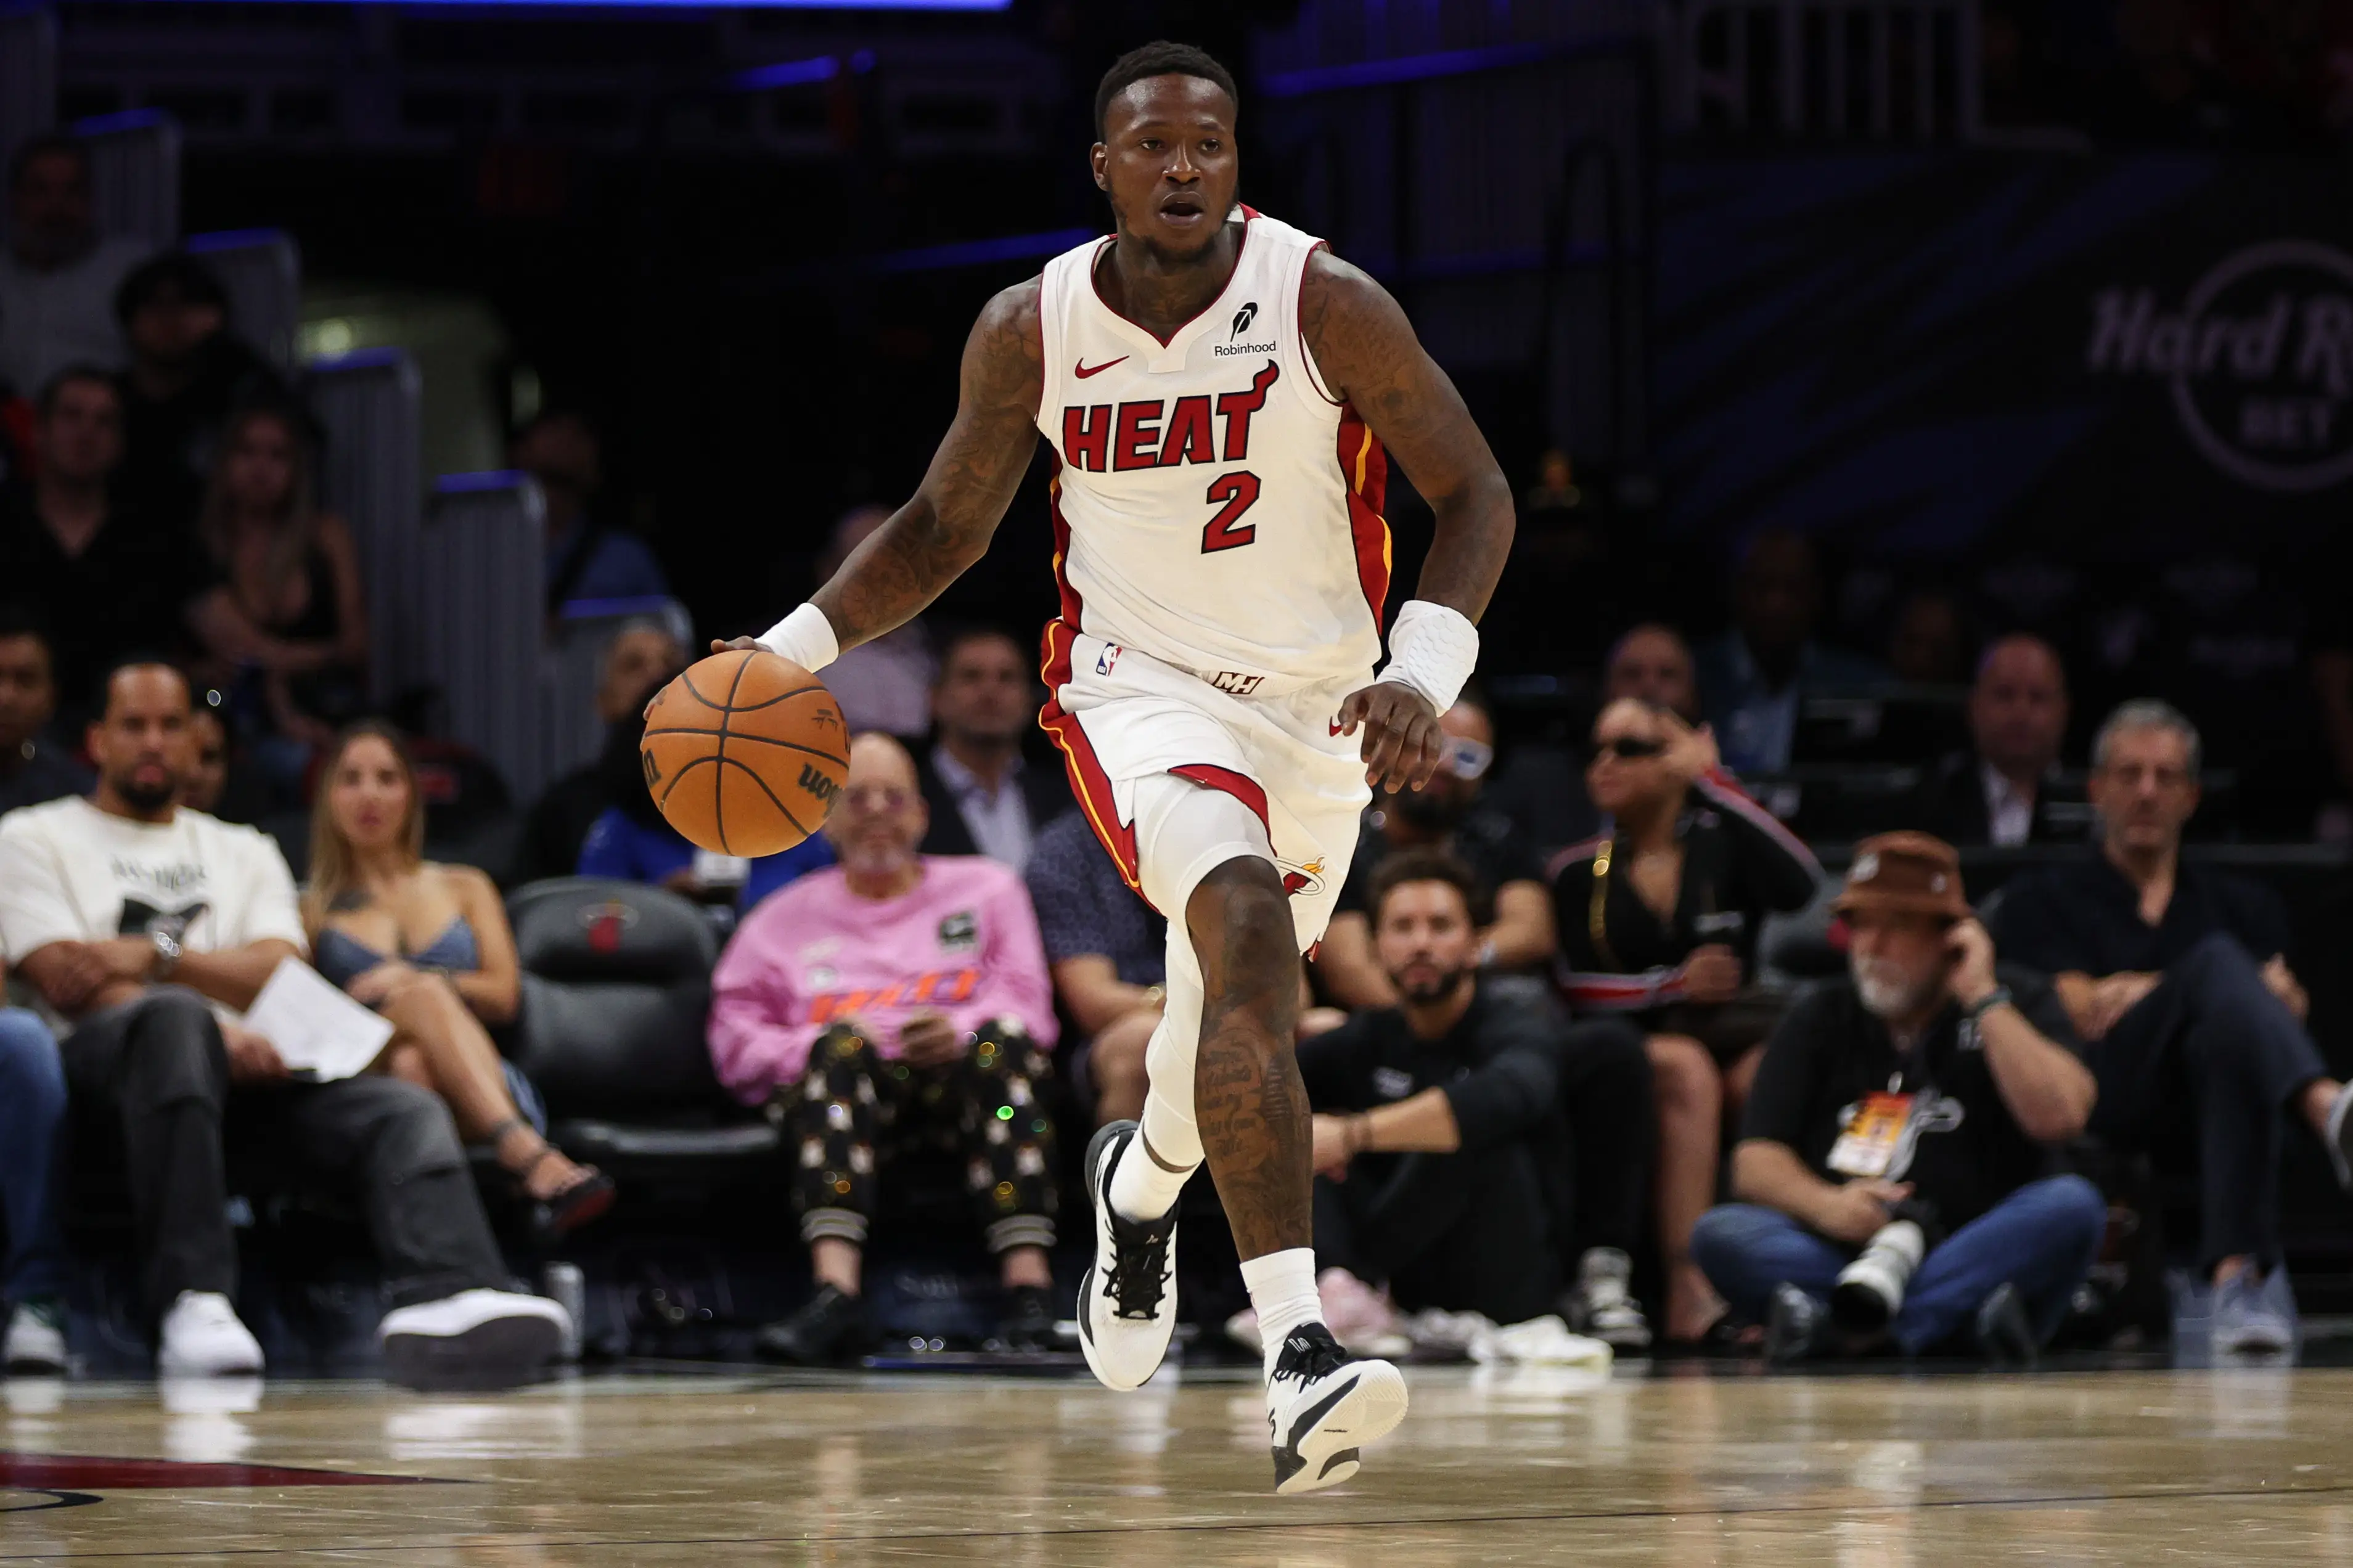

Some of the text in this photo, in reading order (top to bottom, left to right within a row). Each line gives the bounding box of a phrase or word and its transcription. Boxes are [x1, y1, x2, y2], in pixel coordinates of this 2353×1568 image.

[1214, 340, 1277, 356] Robinhood
[2087, 287, 2291, 375] Hard
[1062, 359, 1280, 473] HEAT
[1201, 470, 1261, 554] 2
